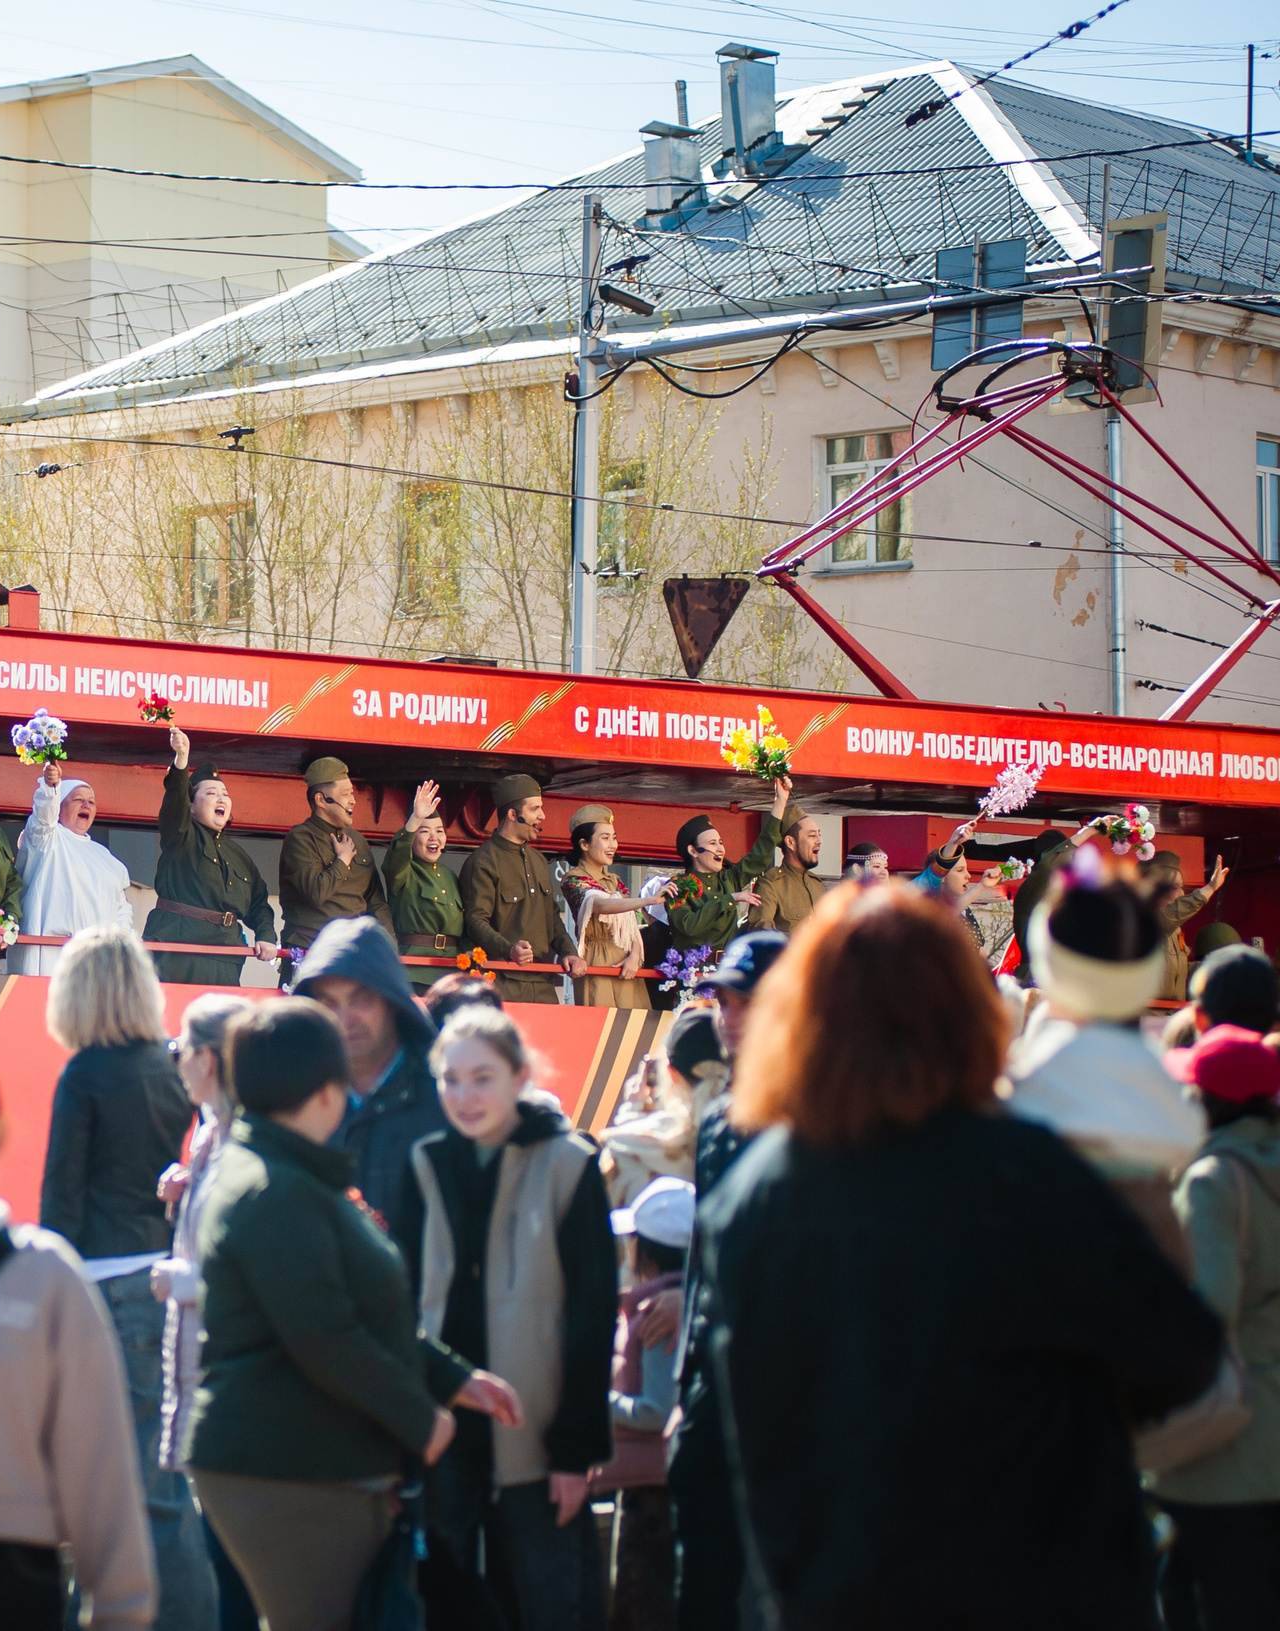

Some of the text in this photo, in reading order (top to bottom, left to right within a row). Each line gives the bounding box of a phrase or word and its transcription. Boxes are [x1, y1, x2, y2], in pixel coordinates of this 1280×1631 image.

[74, 666, 269, 708] НЕИСЧИСЛИМЫ!
[352, 688, 488, 726] ЗА РОДИНУ!
[574, 706, 590, 733] С
[595, 704, 660, 740] ДНЁМ
[1219, 752, 1280, 782] ЛЮБО
